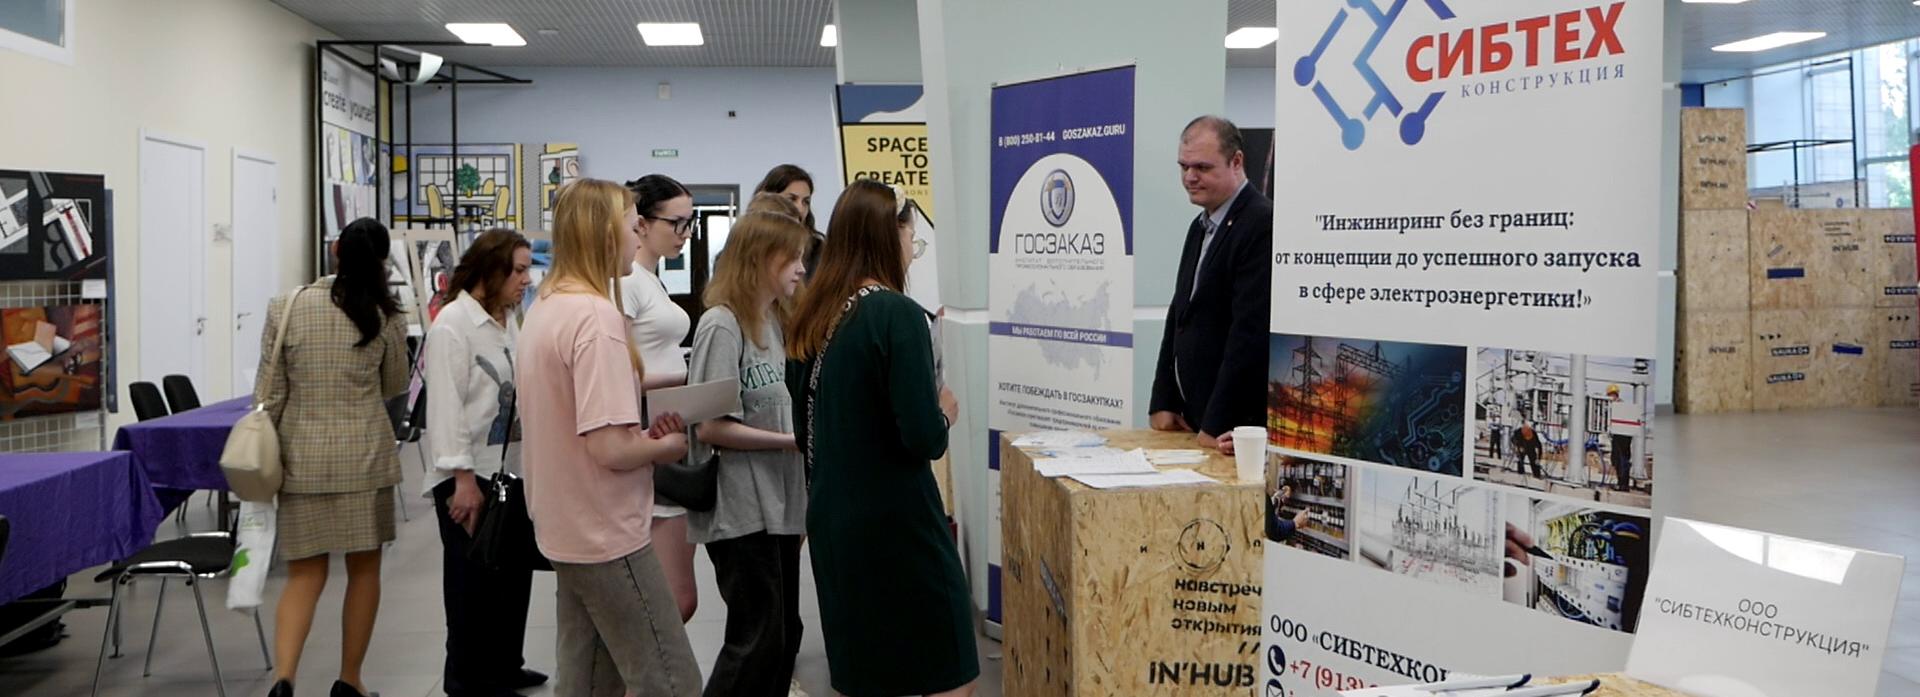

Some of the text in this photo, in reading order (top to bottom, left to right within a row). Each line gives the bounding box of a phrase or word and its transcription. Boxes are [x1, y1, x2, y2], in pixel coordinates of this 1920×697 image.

[1405, 2, 1626, 83] СИБТЕХ
[1461, 64, 1625, 98] КОНСТРУКЦИЯ
[1062, 124, 1126, 140] GOSZAKAZ.GURU
[867, 137, 928, 152] SPACE
[900, 154, 928, 168] TO
[854, 171, 928, 185] CREATE
[1316, 209, 1574, 234] "Инжиниринг без границ:
[1015, 233, 1105, 255] ГОСЗАКАЗ
[1275, 251, 1642, 273] от концепции до успешного запуска
[1299, 282, 1592, 311] в сфере электроэнергетики!»
[1023, 326, 1054, 337] РАБОТАЕМ
[1063, 329, 1079, 340] ВСЕЙ
[1080, 332, 1107, 343] РОССИИ
[998, 382, 1124, 409] ХОТИТЕ ПОБЕЖДАТЬ В ГОСЗАКУПКАХ?
[1174, 578, 1262, 597] навстреч
[1173, 598, 1237, 614] новым
[1738, 599, 1778, 619] ООО
[1171, 617, 1262, 636] открытия
[1270, 614, 1308, 643] ООО
[1655, 597, 1870, 658] "СИБТЕХКОНСТРУКЦИЯ"
[1149, 661, 1255, 687] IN'HUB
[1290, 660, 1364, 692] +7 (913)
